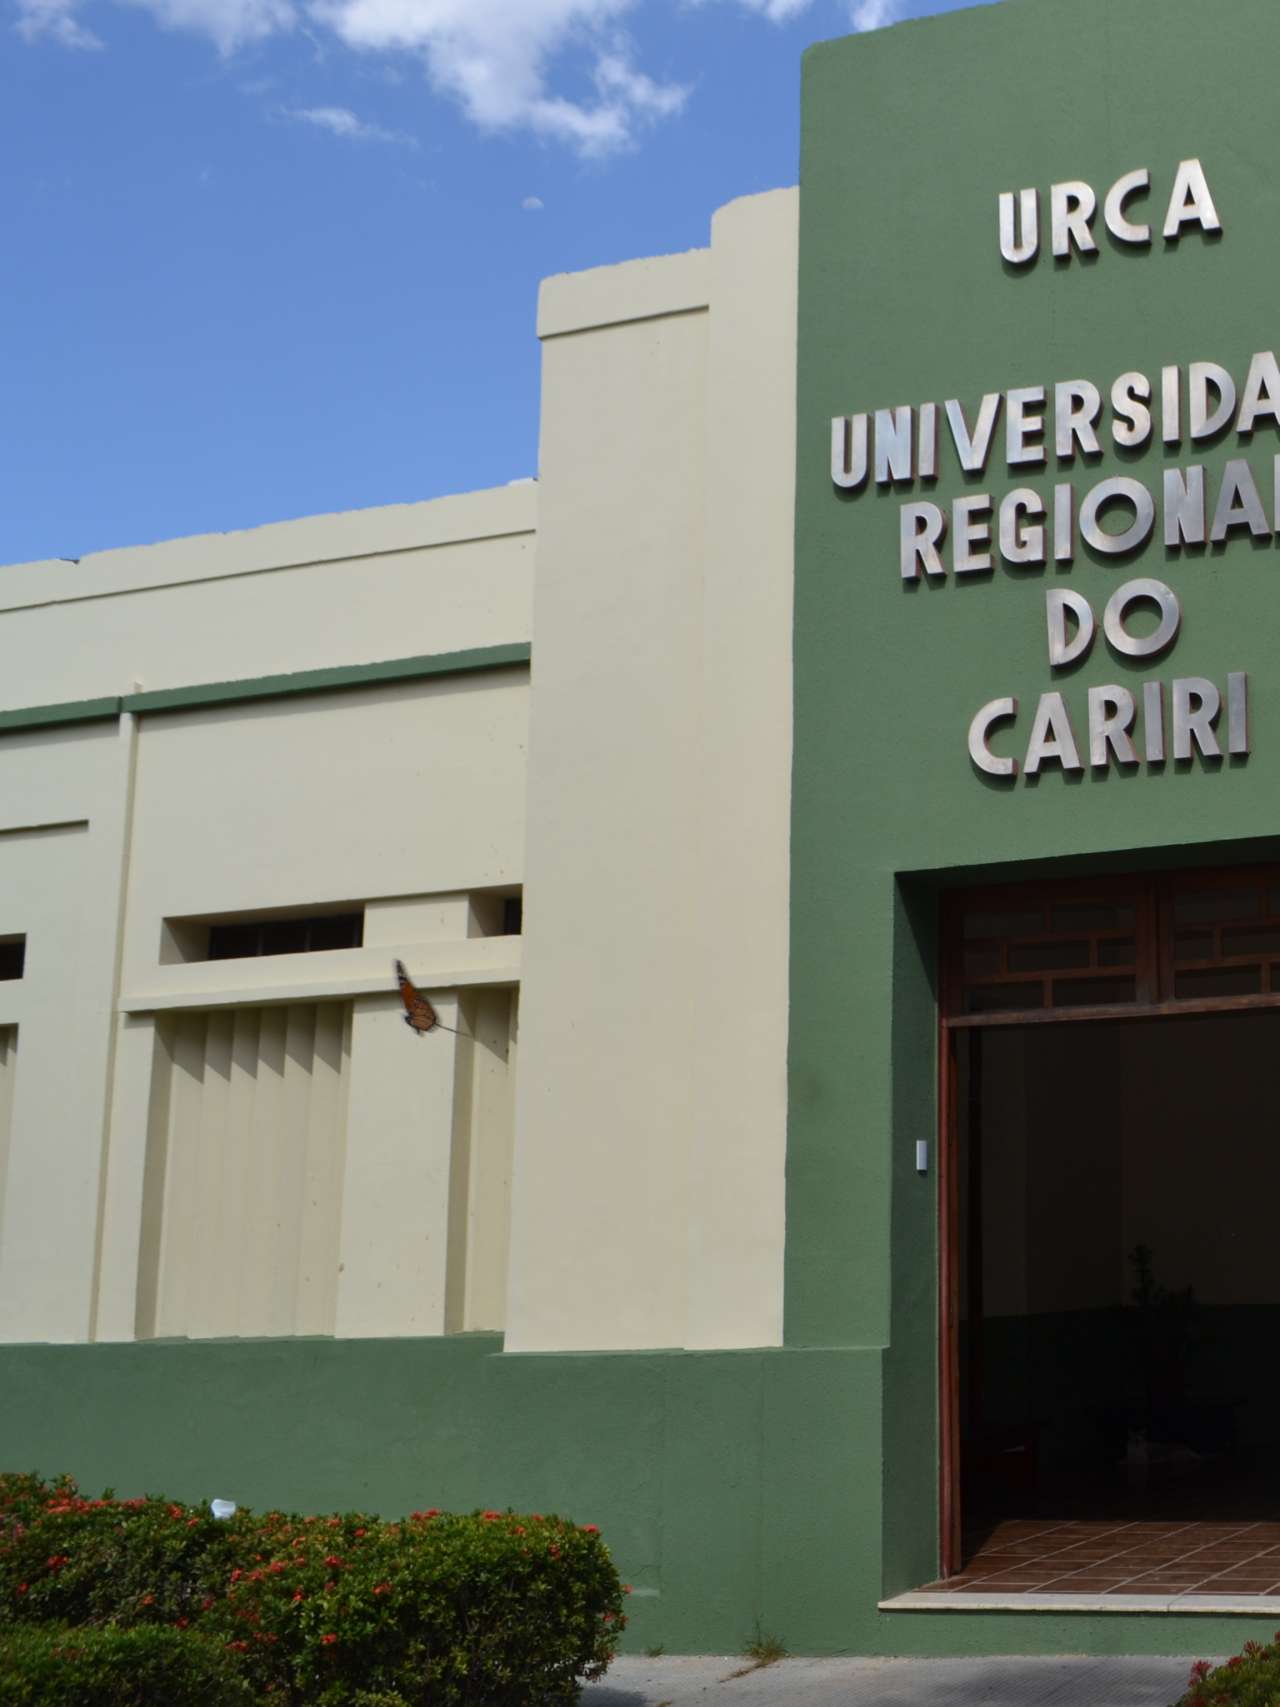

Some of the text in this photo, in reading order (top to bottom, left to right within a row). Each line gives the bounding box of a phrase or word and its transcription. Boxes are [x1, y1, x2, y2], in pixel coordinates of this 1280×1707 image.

[999, 157, 1222, 264] URCA
[1046, 578, 1182, 667] DO
[967, 671, 1251, 777] CARIRI
